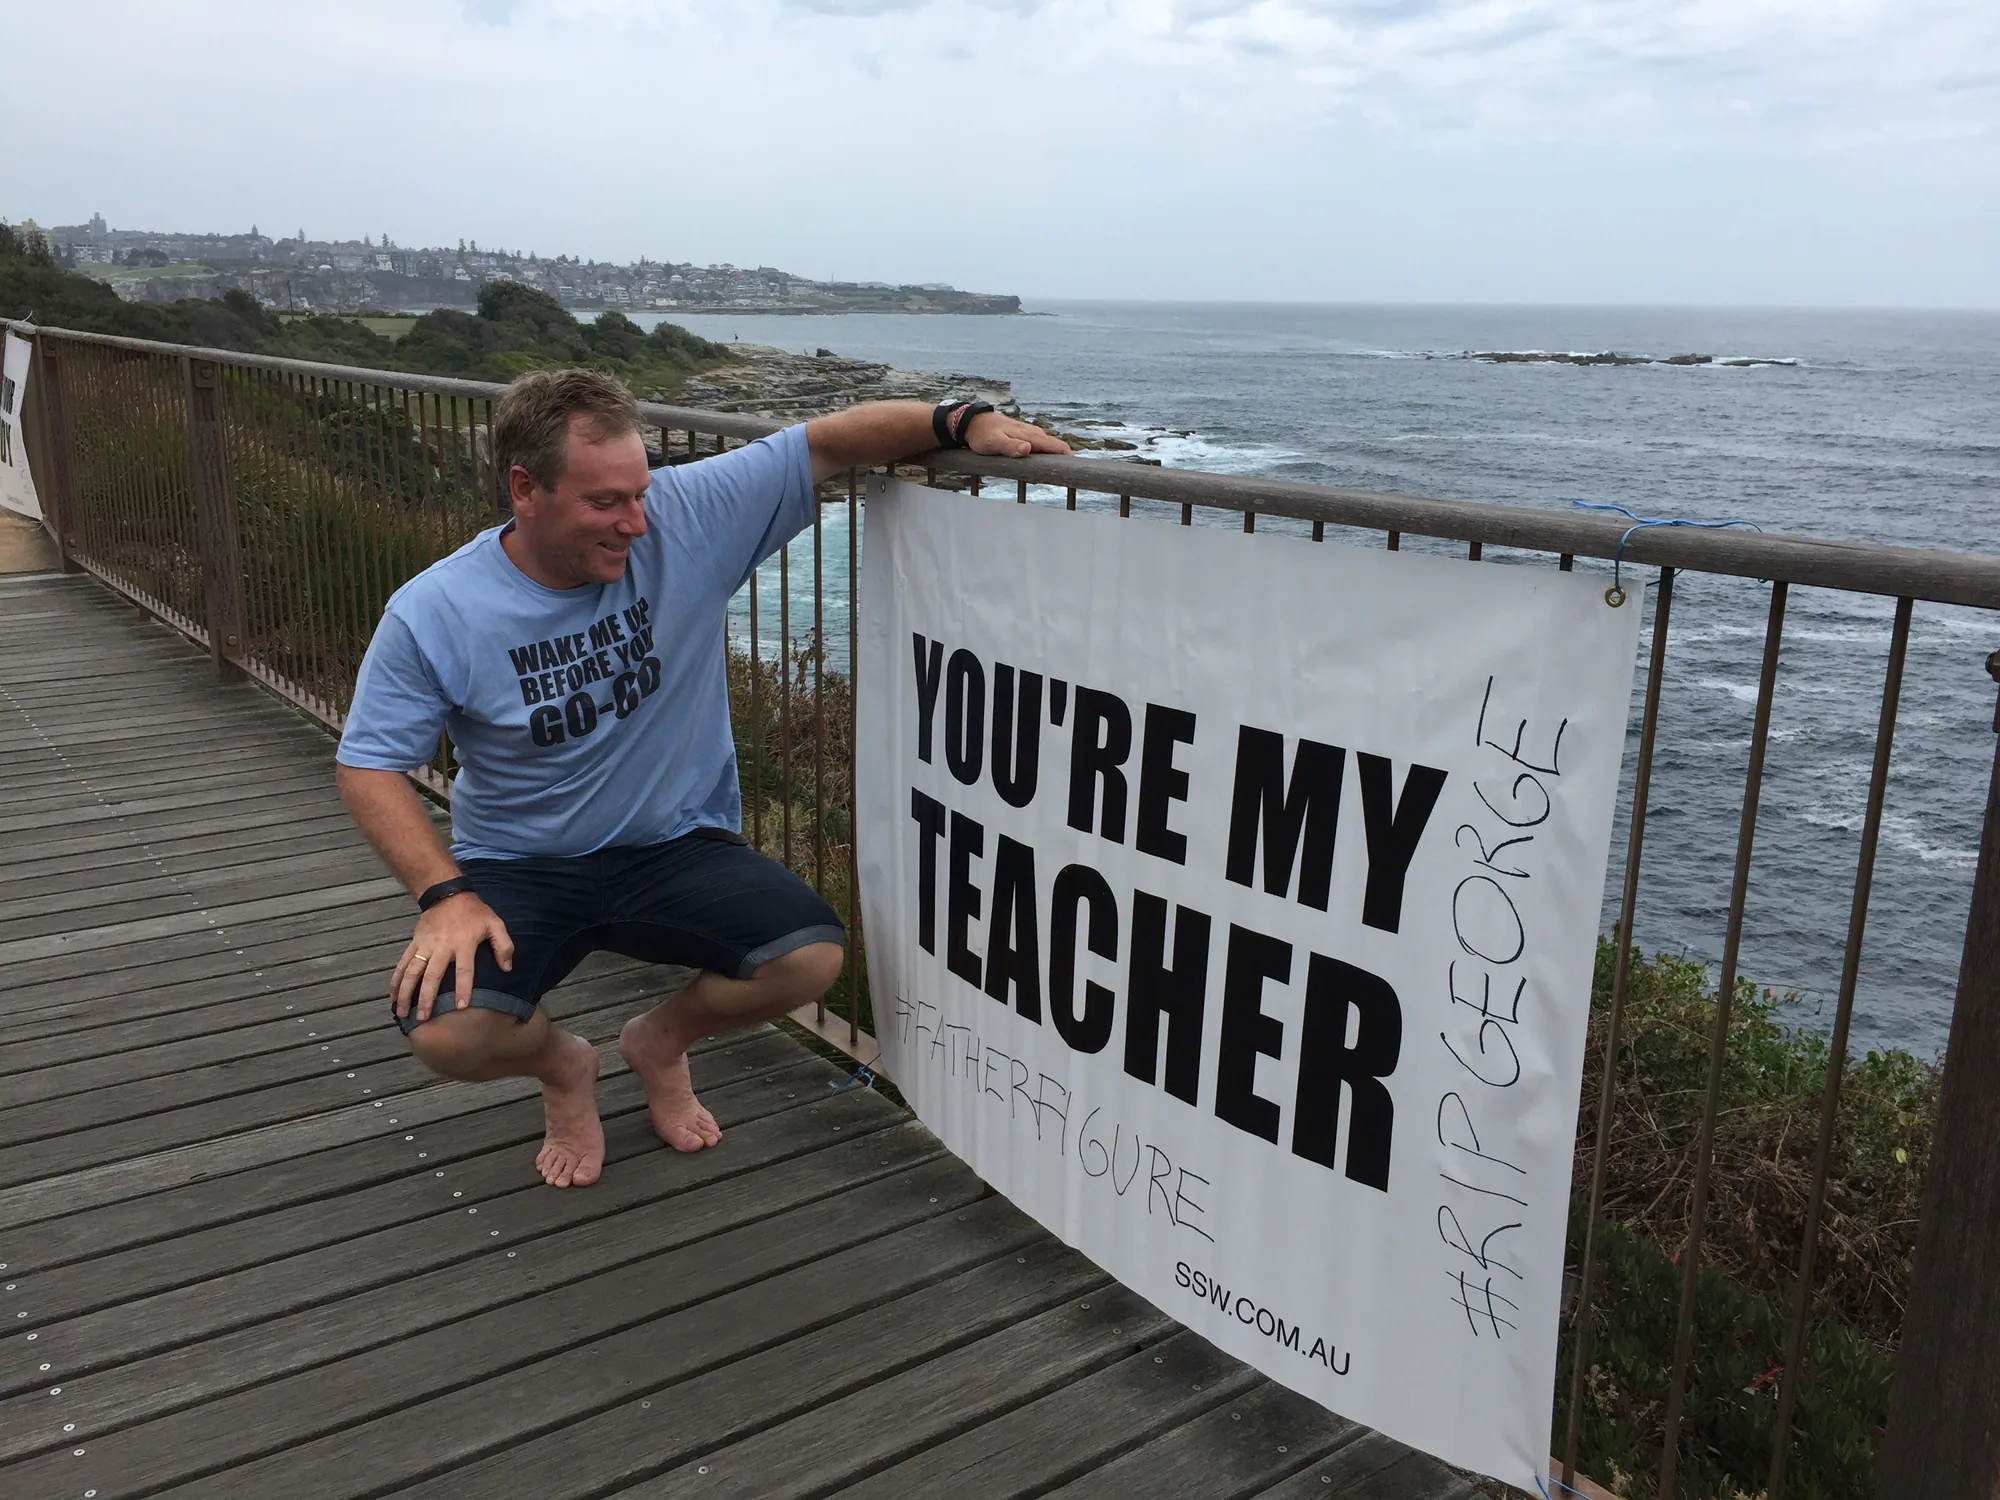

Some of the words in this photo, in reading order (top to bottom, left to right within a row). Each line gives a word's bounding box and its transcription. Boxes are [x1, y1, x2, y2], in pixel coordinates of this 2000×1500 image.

[508, 632, 588, 676] WAKE
[588, 614, 626, 650] ME
[623, 596, 650, 634] UP
[519, 651, 615, 706] BEFORE
[613, 625, 655, 670] YOU
[912, 632, 1197, 866] YOU'RE
[1225, 724, 1449, 935] MY
[911, 786, 1403, 1193] TEACHER
[895, 981, 1214, 1242] #FATHERFIGURE
[1175, 1261, 1351, 1376] SSW.COM.AU
